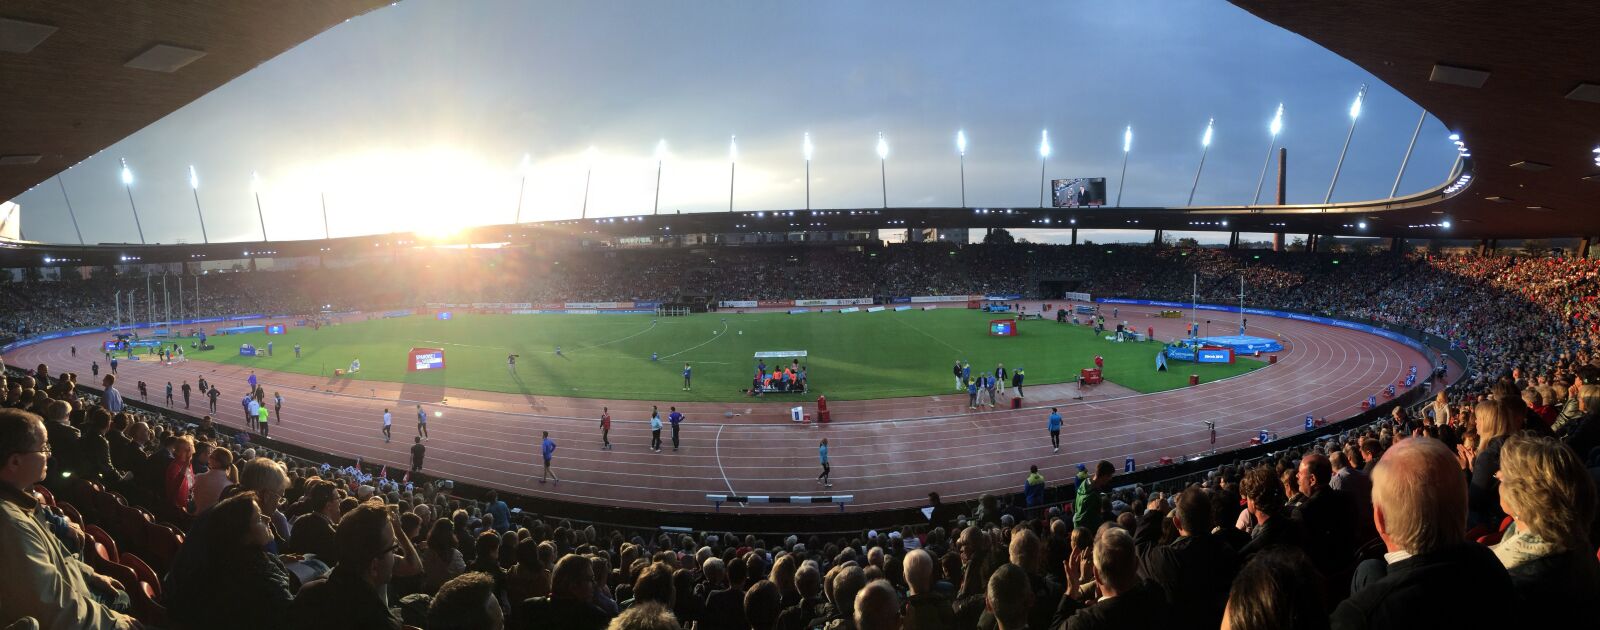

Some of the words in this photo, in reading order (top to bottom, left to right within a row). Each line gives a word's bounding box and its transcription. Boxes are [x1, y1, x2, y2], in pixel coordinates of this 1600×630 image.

[1306, 418, 1312, 428] 3
[1261, 433, 1268, 443] 2
[1126, 461, 1133, 472] 1
